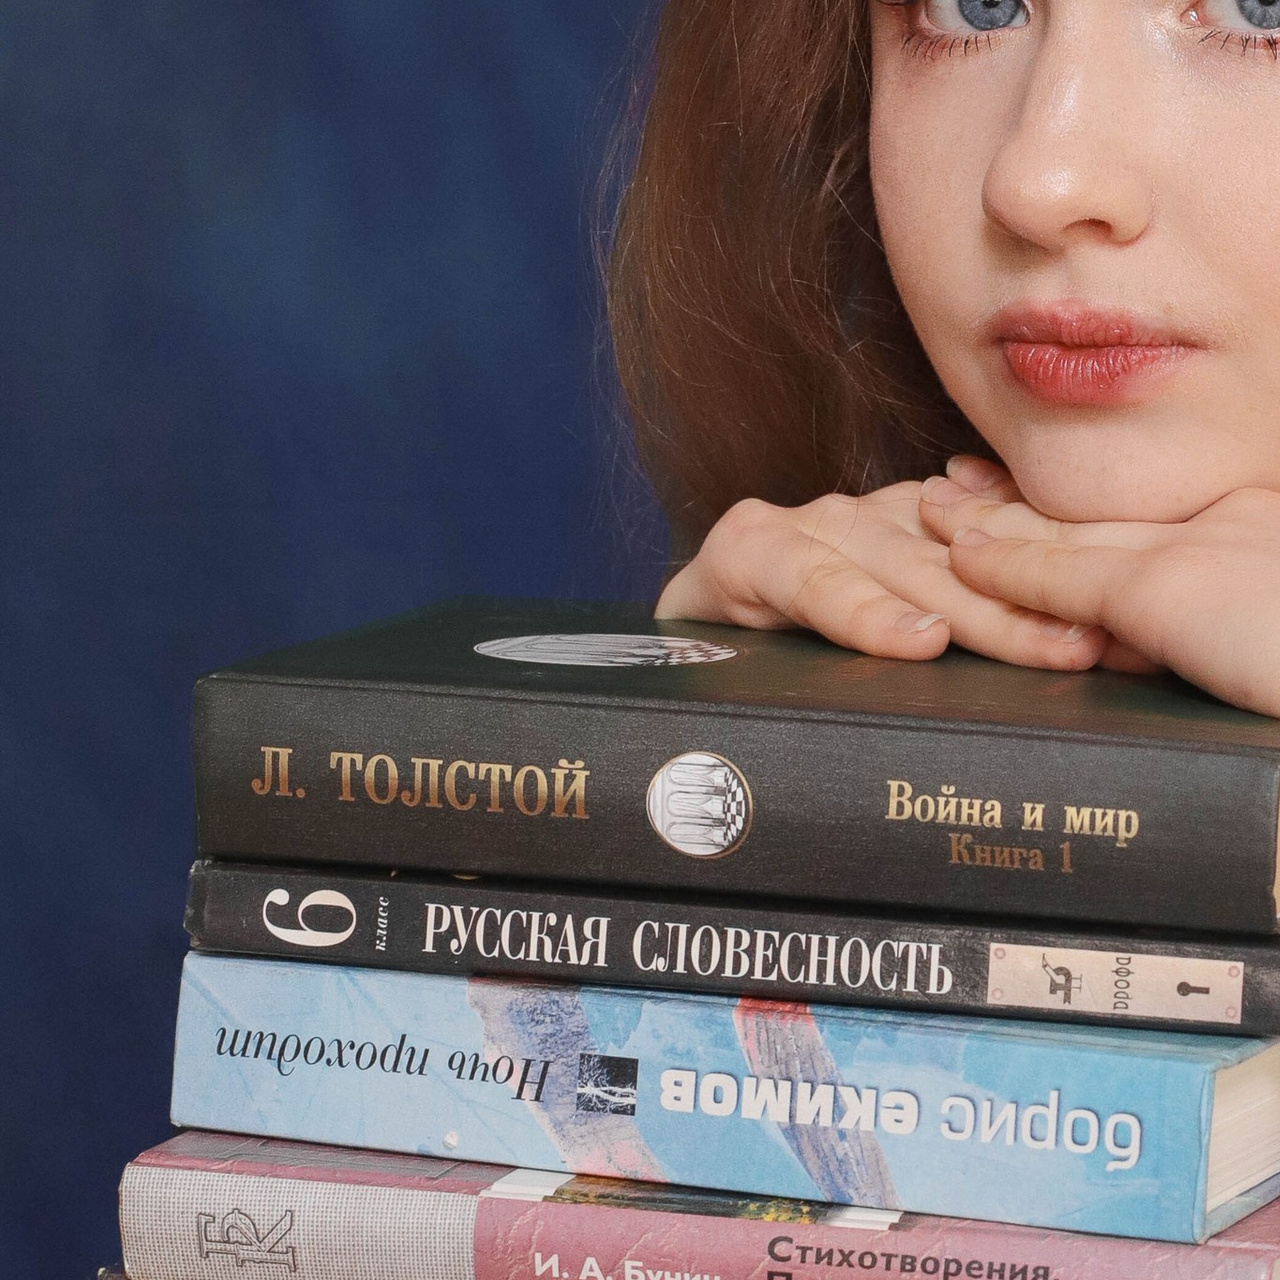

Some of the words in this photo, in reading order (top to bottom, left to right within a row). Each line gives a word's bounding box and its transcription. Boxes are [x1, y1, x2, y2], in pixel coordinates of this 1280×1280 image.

[251, 746, 305, 798] Л.
[330, 751, 590, 819] ТОЛСТОЙ
[885, 780, 1002, 829] Война
[1022, 801, 1045, 832] и
[1063, 803, 1140, 846] мир
[948, 833, 1045, 872] Книга
[1059, 843, 1074, 874] 1
[262, 888, 357, 947] 6
[375, 895, 389, 952] класс
[421, 902, 612, 967] РУССКАЯ
[632, 920, 953, 996] СЛОВЕСНОСТЬ
[216, 1025, 430, 1078] проходит
[448, 1049, 555, 1104] Ночь
[534, 1252, 569, 1278] И.
